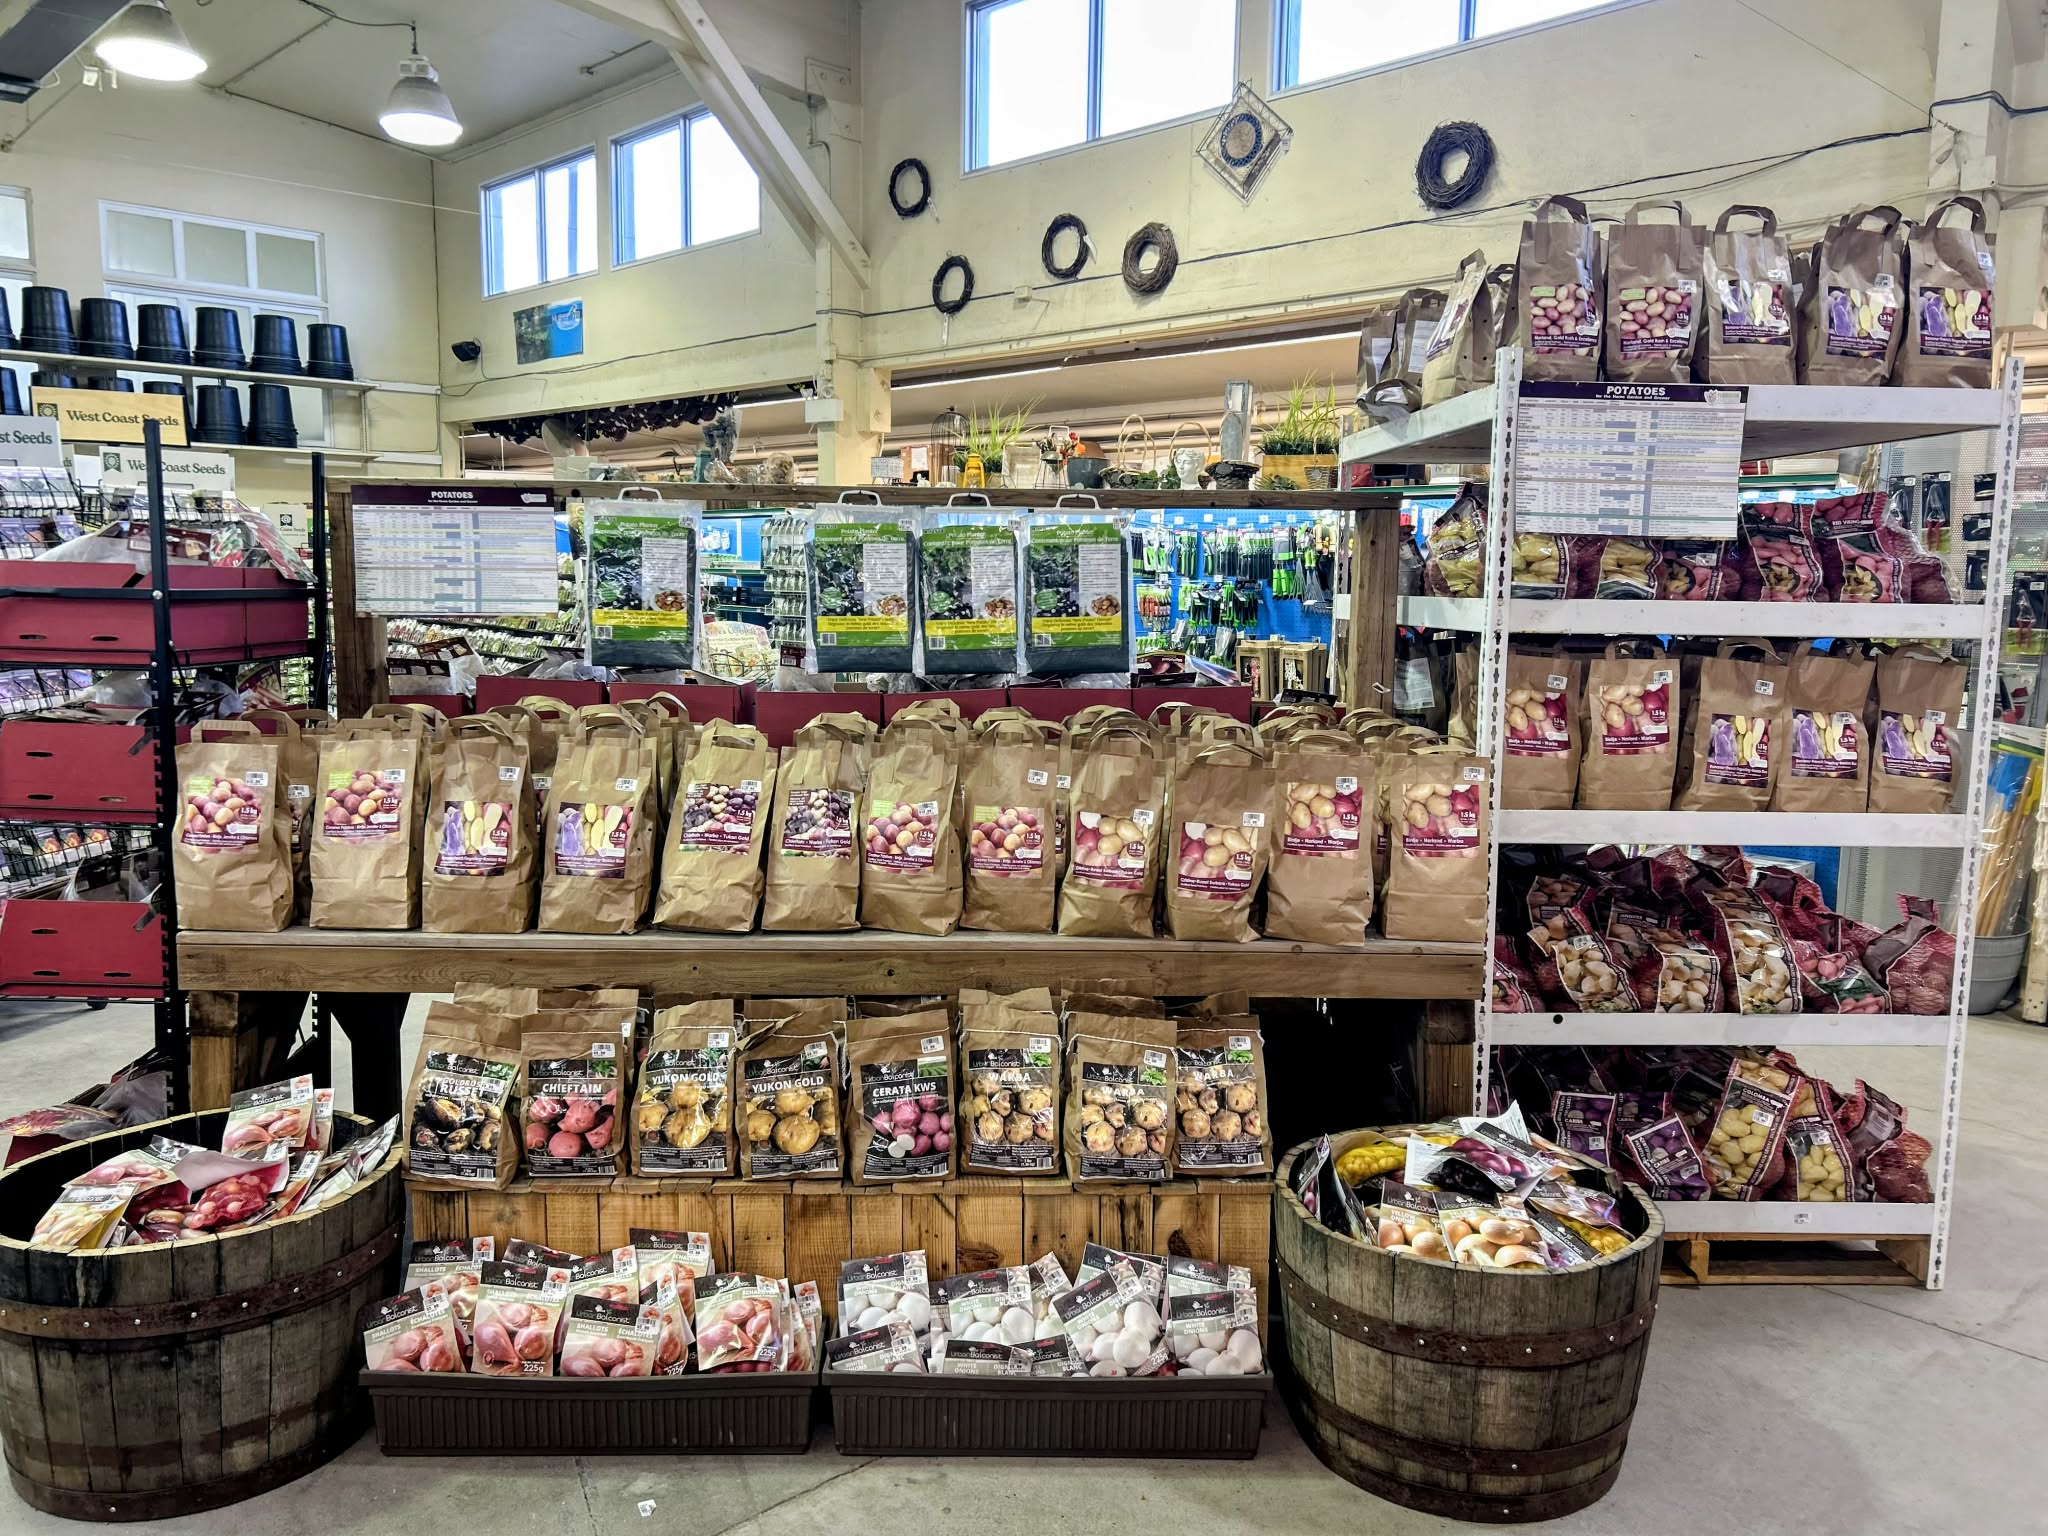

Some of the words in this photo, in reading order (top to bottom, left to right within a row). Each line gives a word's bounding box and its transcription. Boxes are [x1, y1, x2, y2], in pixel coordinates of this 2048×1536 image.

[1606, 385, 1666, 396] POTATOES
[66, 410, 100, 422] West
[102, 412, 140, 424] Coast
[13, 431, 53, 444] Seeds
[193, 463, 226, 475] Seeds
[431, 491, 474, 499] POTATOES
[1659, 710, 1665, 718] kg
[1350, 814, 1358, 822] kg
[1468, 812, 1475, 820] kg
[1137, 844, 1144, 852] kg
[1244, 854, 1250, 862] kg
[652, 1073, 689, 1085] YUKON
[691, 1072, 719, 1082] GOLD
[989, 1072, 1032, 1082] WARBA
[1193, 1069, 1234, 1083] WARBA
[542, 1083, 602, 1094] CHIEFTAIN
[752, 1081, 791, 1094] YUKON
[794, 1076, 824, 1088] GOLD
[872, 1085, 912, 1098] CERATA
[914, 1081, 936, 1093] KWS
[1101, 1085, 1145, 1097] WARBA
[1742, 1087, 1770, 1103] COLOMBA
[959, 1303, 982, 1312] ONIONS
[371, 1324, 401, 1339] SHALLOTS
[576, 1323, 609, 1333] SHALLOTS
[1184, 1327, 1209, 1336] ONIONS
[523, 1363, 544, 1374] 225g
